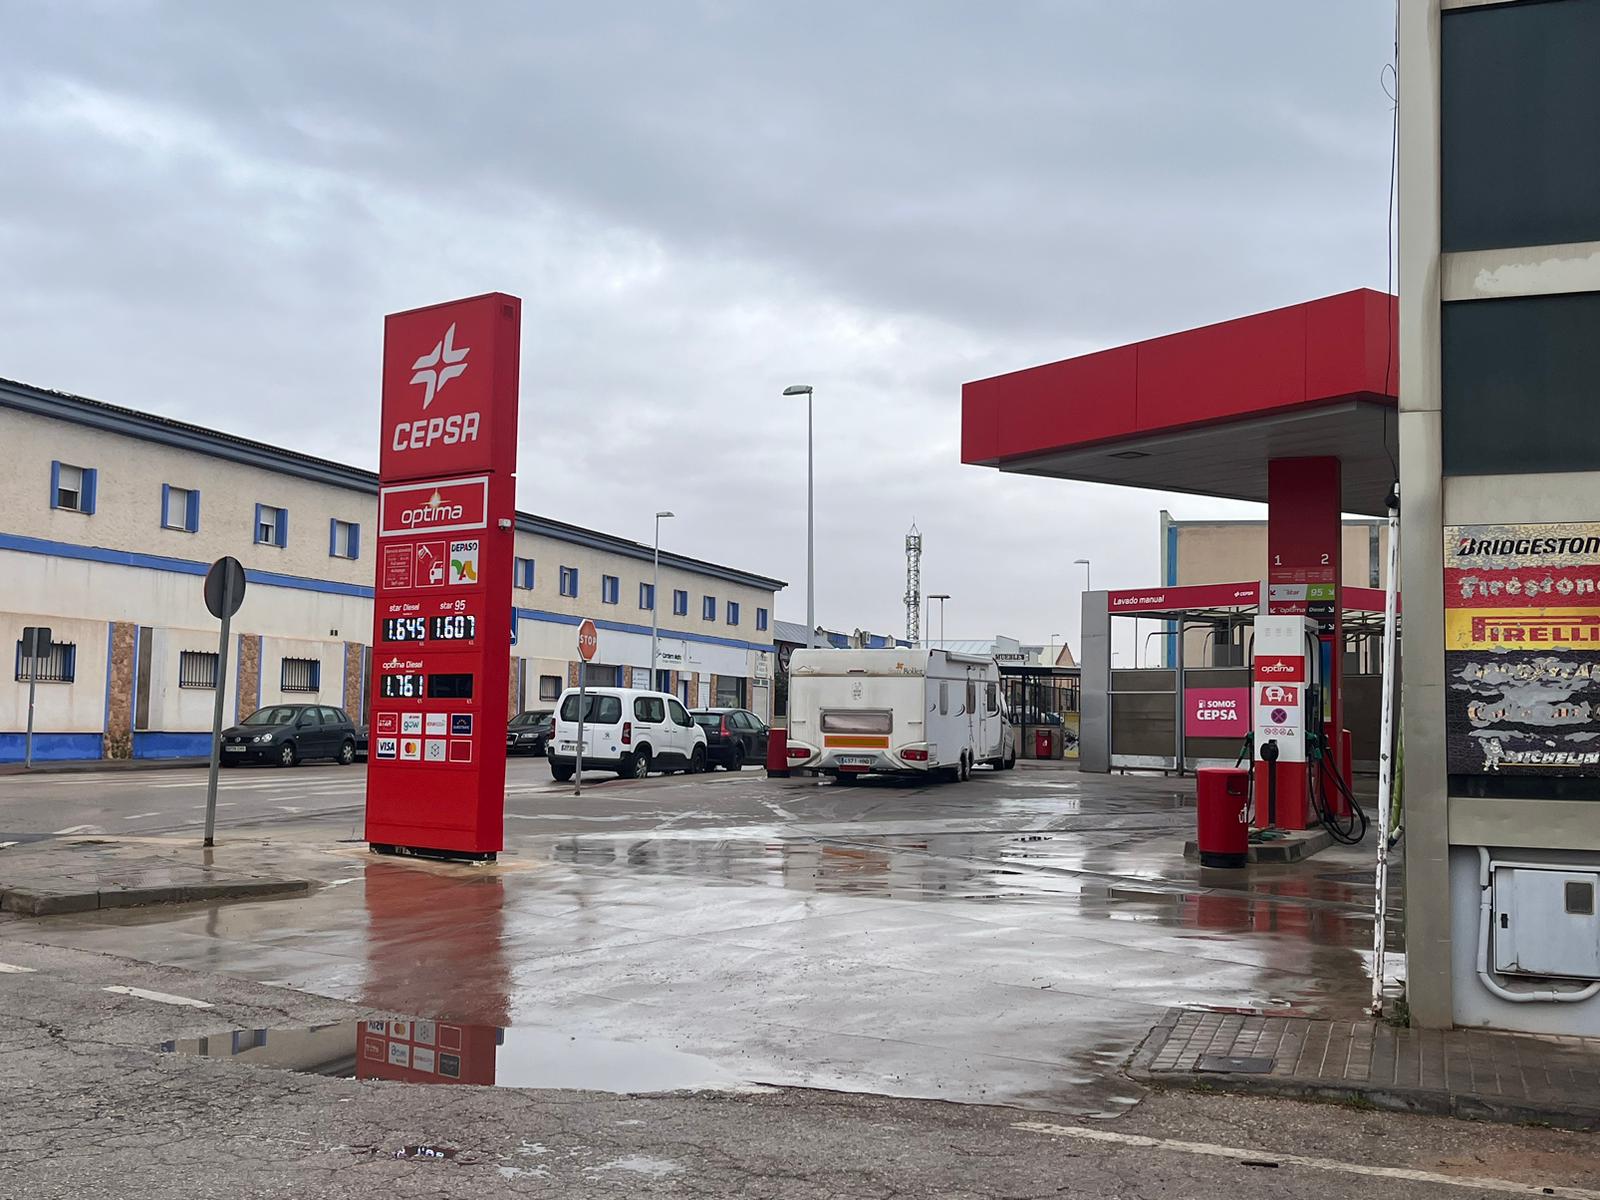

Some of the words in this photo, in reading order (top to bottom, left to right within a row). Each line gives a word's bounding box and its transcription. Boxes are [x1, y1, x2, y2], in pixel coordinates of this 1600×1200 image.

[392, 412, 480, 451] CEPSA
[401, 505, 463, 528] optima
[451, 542, 478, 552] DEPASO
[1274, 555, 1282, 566] 1
[1321, 553, 1329, 565] 2
[1459, 575, 1600, 598] Fireston
[1311, 588, 1323, 597] 95
[440, 602, 453, 610] star
[454, 600, 466, 611] 95
[1113, 597, 1138, 606] Lavado
[1139, 595, 1165, 604] manual
[403, 603, 420, 611] Diesel
[388, 617, 426, 640] 1.645
[436, 615, 475, 639] 1.607
[1471, 616, 1600, 641] PIRELLI
[579, 634, 596, 645] STOP
[382, 662, 405, 670] optima
[405, 660, 423, 668] Diesel
[386, 674, 424, 697] 1.761
[1207, 700, 1236, 708] SOMOS
[1197, 709, 1237, 720] CEPSA
[380, 741, 395, 751] VISA
[1504, 750, 1599, 764] MICHELIN
